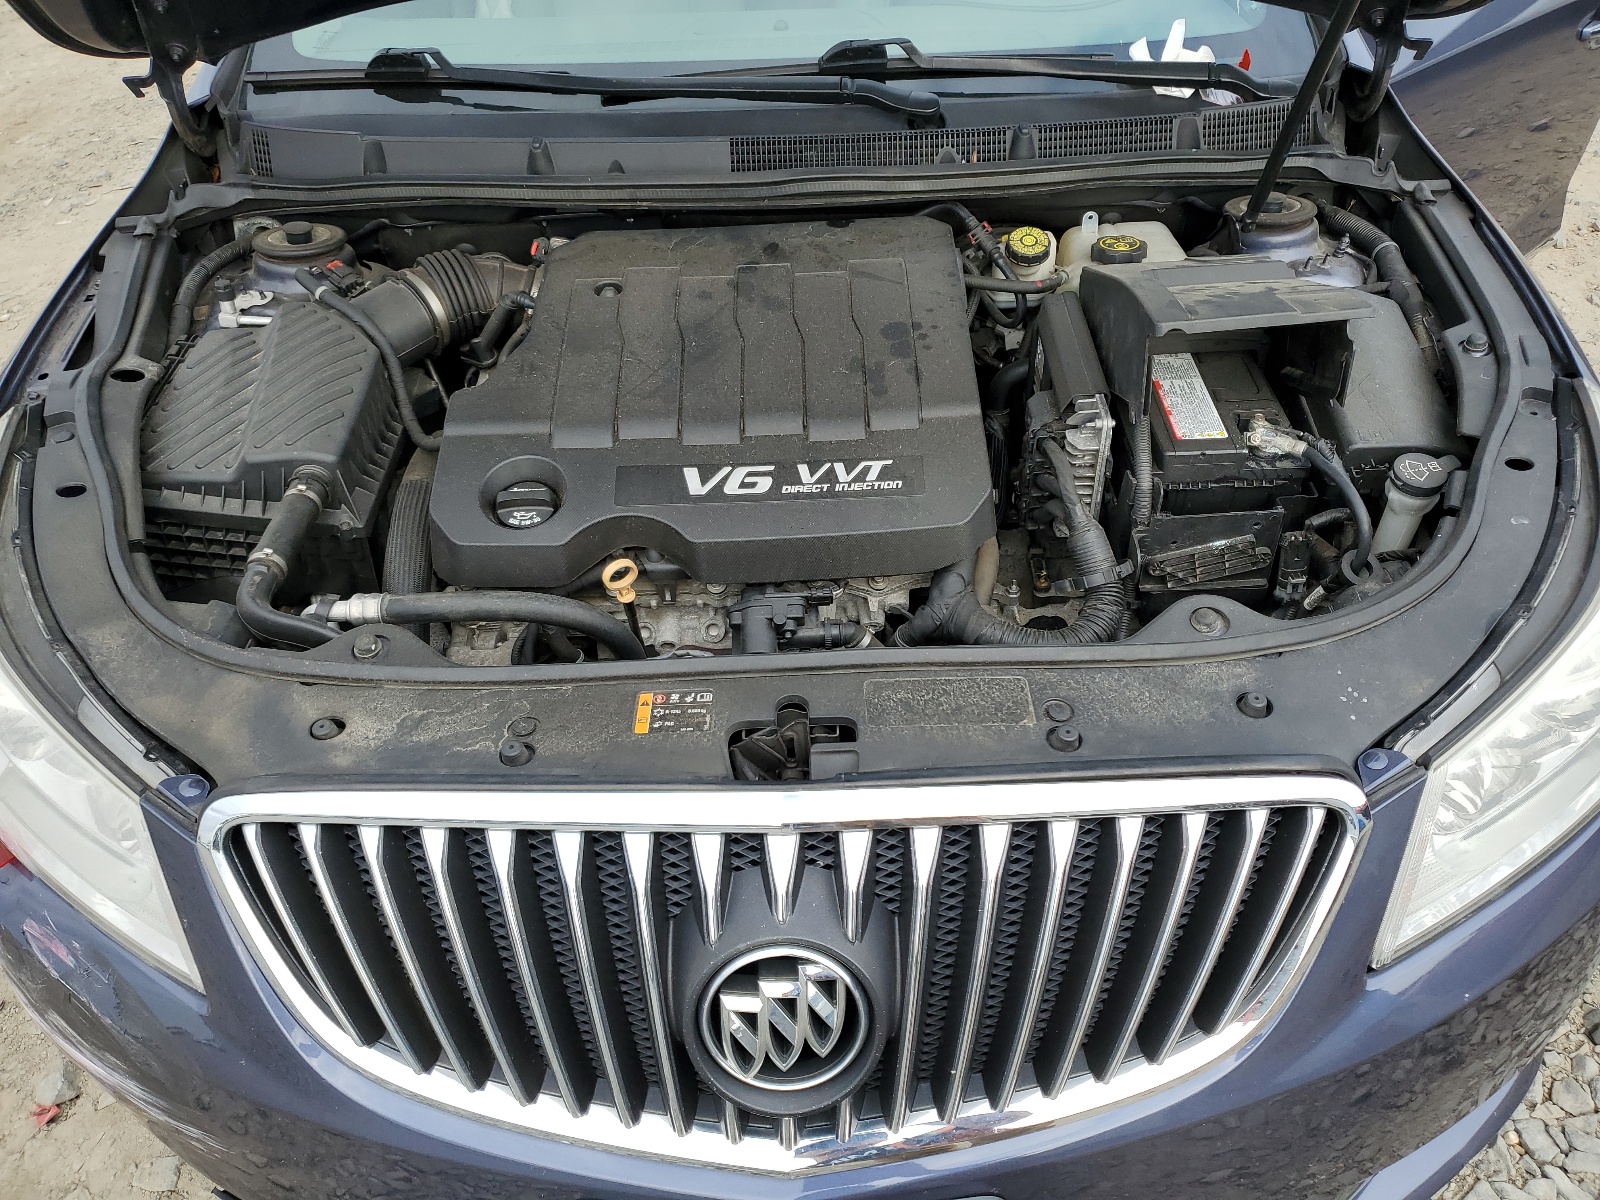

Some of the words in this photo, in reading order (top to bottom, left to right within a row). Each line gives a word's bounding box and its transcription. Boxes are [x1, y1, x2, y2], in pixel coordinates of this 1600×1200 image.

[682, 465, 775, 496] V6
[796, 459, 893, 484] VVT
[781, 484, 830, 494] DIRECT
[835, 480, 903, 492] INJECTION
